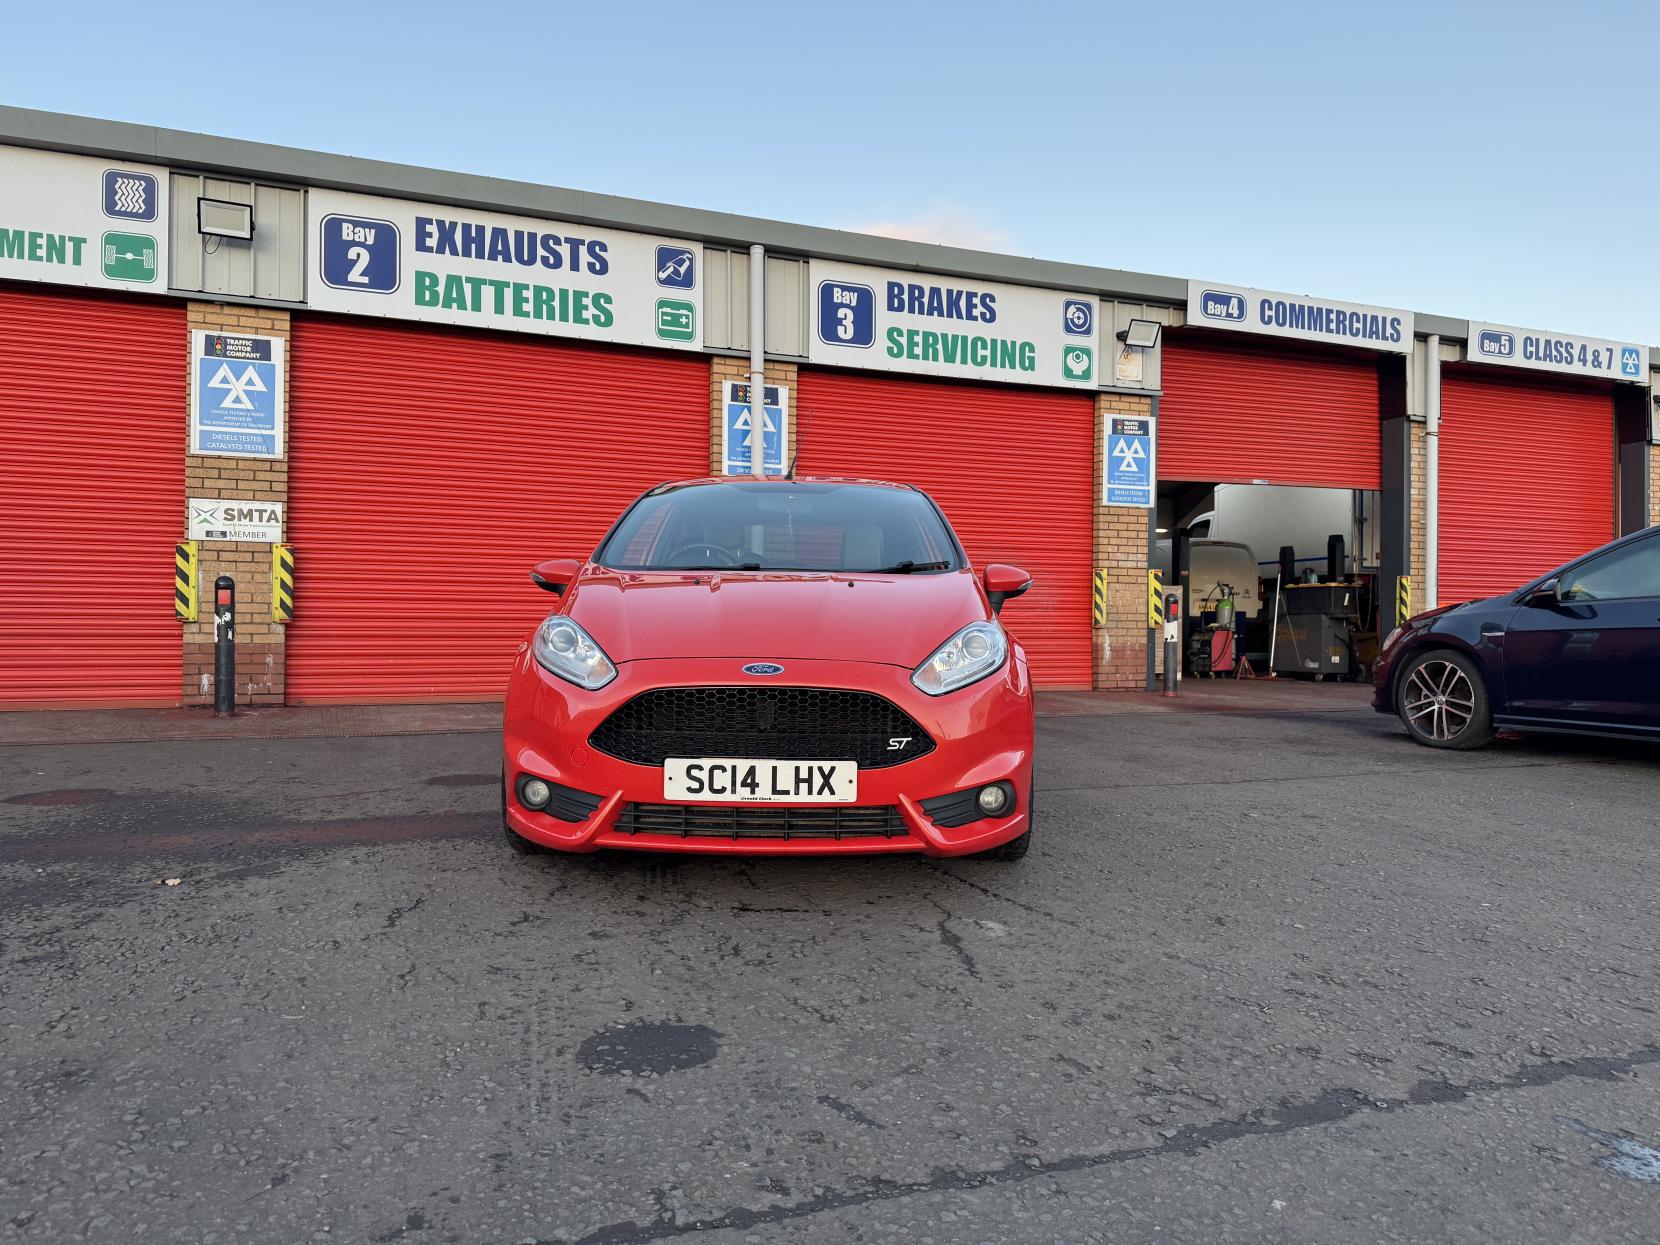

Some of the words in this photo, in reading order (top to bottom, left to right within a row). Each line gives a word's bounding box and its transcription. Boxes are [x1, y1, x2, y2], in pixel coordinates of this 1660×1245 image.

[342, 222, 376, 245] Bay
[0, 228, 87, 266] MENT
[415, 216, 610, 276] EXHAUSTS
[347, 247, 370, 284] 2
[414, 270, 614, 328] BATTERIES
[833, 287, 858, 307] Bay
[886, 280, 997, 324] BRAKES
[1207, 301, 1228, 317] Bay
[1228, 297, 1239, 318] 4
[837, 308, 854, 340] 3
[1259, 298, 1401, 343] COMMERCIALS
[226, 351, 260, 359] COMPANY
[886, 326, 1036, 373] SERVICING
[1483, 339, 1500, 353] Bay
[1500, 335, 1509, 354] 5
[1523, 335, 1574, 366] CLASS
[1578, 343, 1588, 367] 4
[1591, 348, 1603, 369] &
[1605, 347, 1614, 370] 7
[206, 442, 243, 450] CATALYSTS
[212, 433, 237, 441] DIESELS
[223, 507, 280, 523] SMTA
[229, 530, 267, 539] MEMBER
[751, 665, 775, 673] Ford
[886, 737, 913, 750] ST
[685, 763, 760, 795] SC14
[771, 765, 837, 796] LHX
